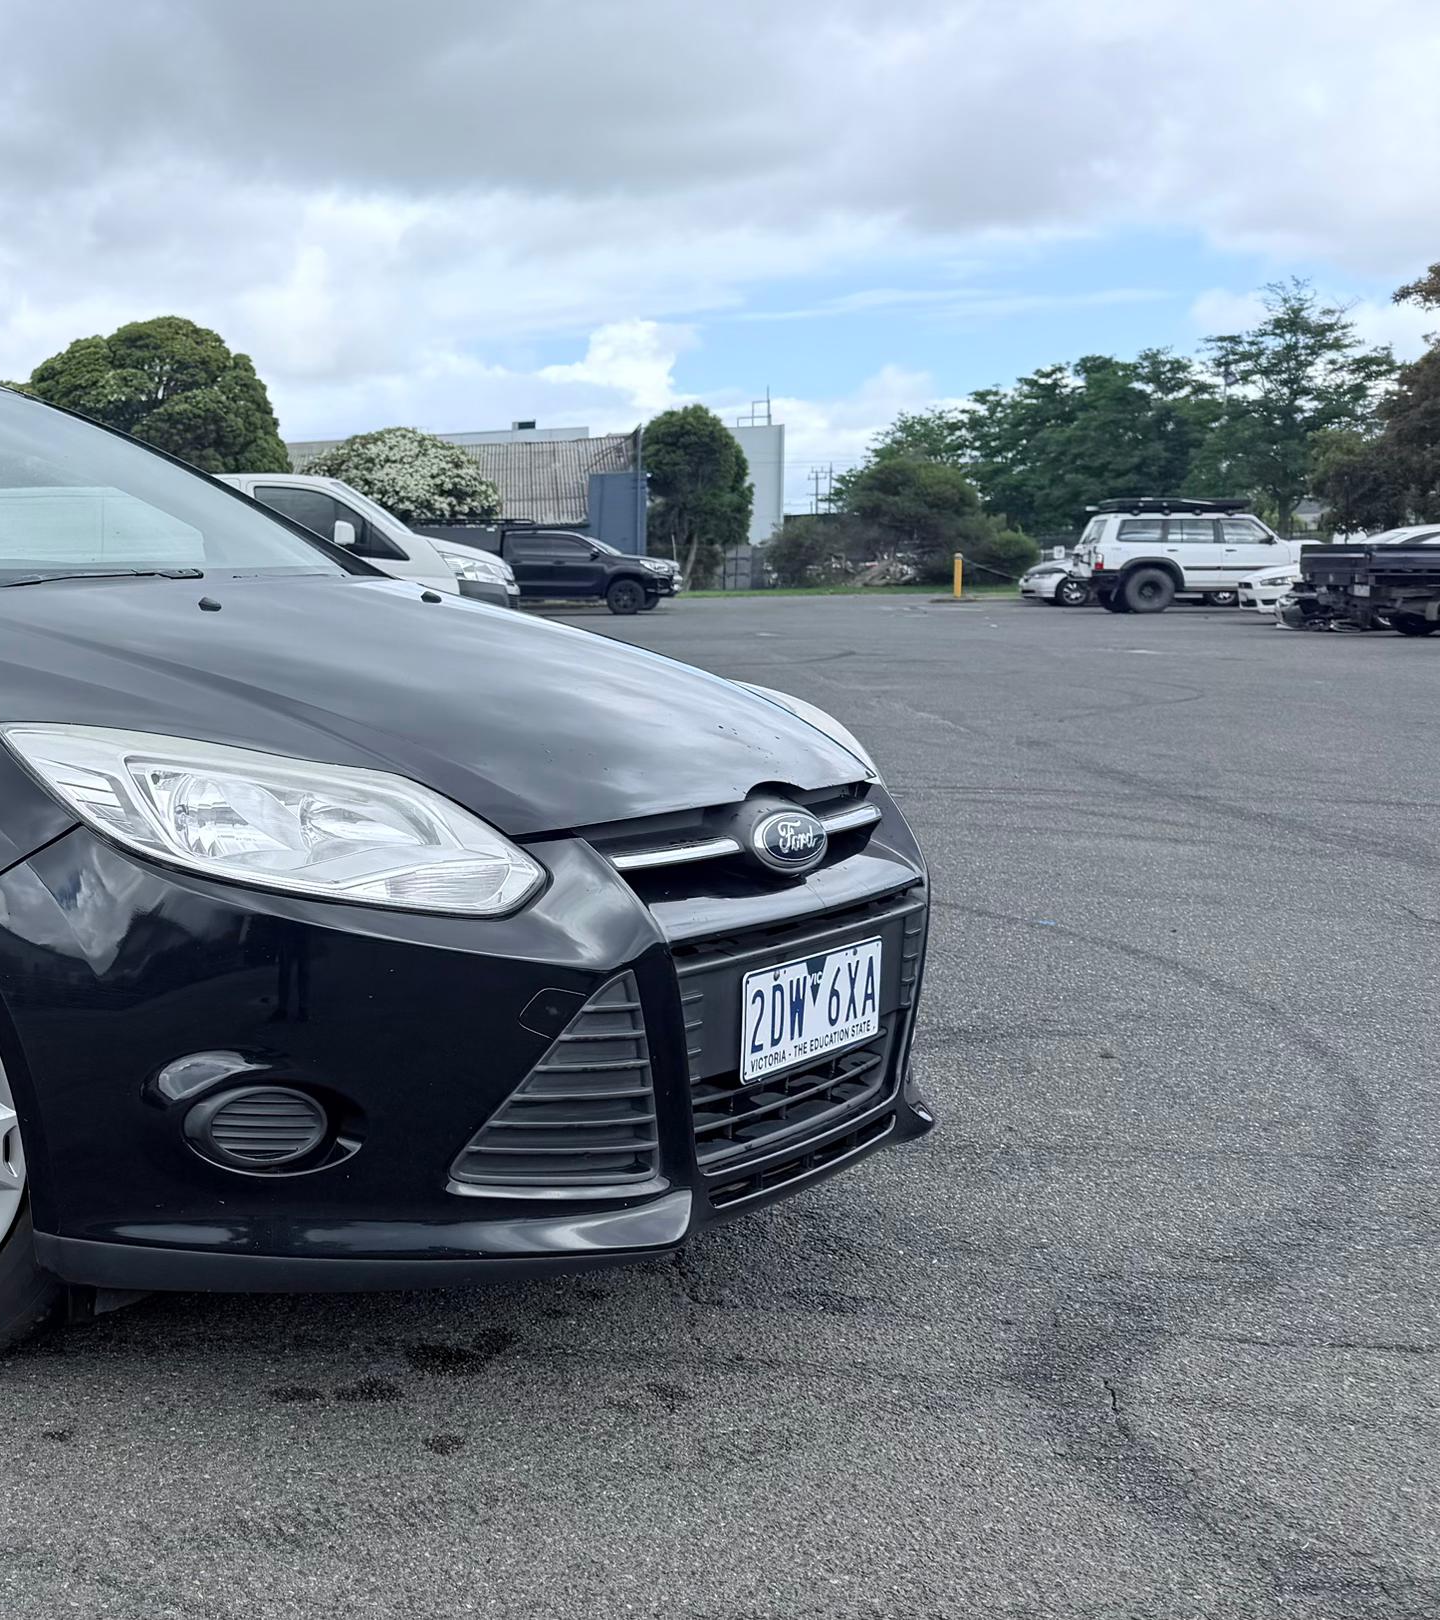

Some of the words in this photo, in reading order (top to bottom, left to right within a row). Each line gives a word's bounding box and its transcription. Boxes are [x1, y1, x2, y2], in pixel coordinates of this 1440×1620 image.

[778, 820, 817, 854] Ford
[751, 975, 807, 1054] 2DW
[828, 955, 876, 1027] 6XA
[750, 1050, 787, 1072] VICTORIA
[793, 1043, 808, 1056] THE
[810, 1029, 849, 1052] EDUCATION
[851, 1020, 871, 1038] STATE
